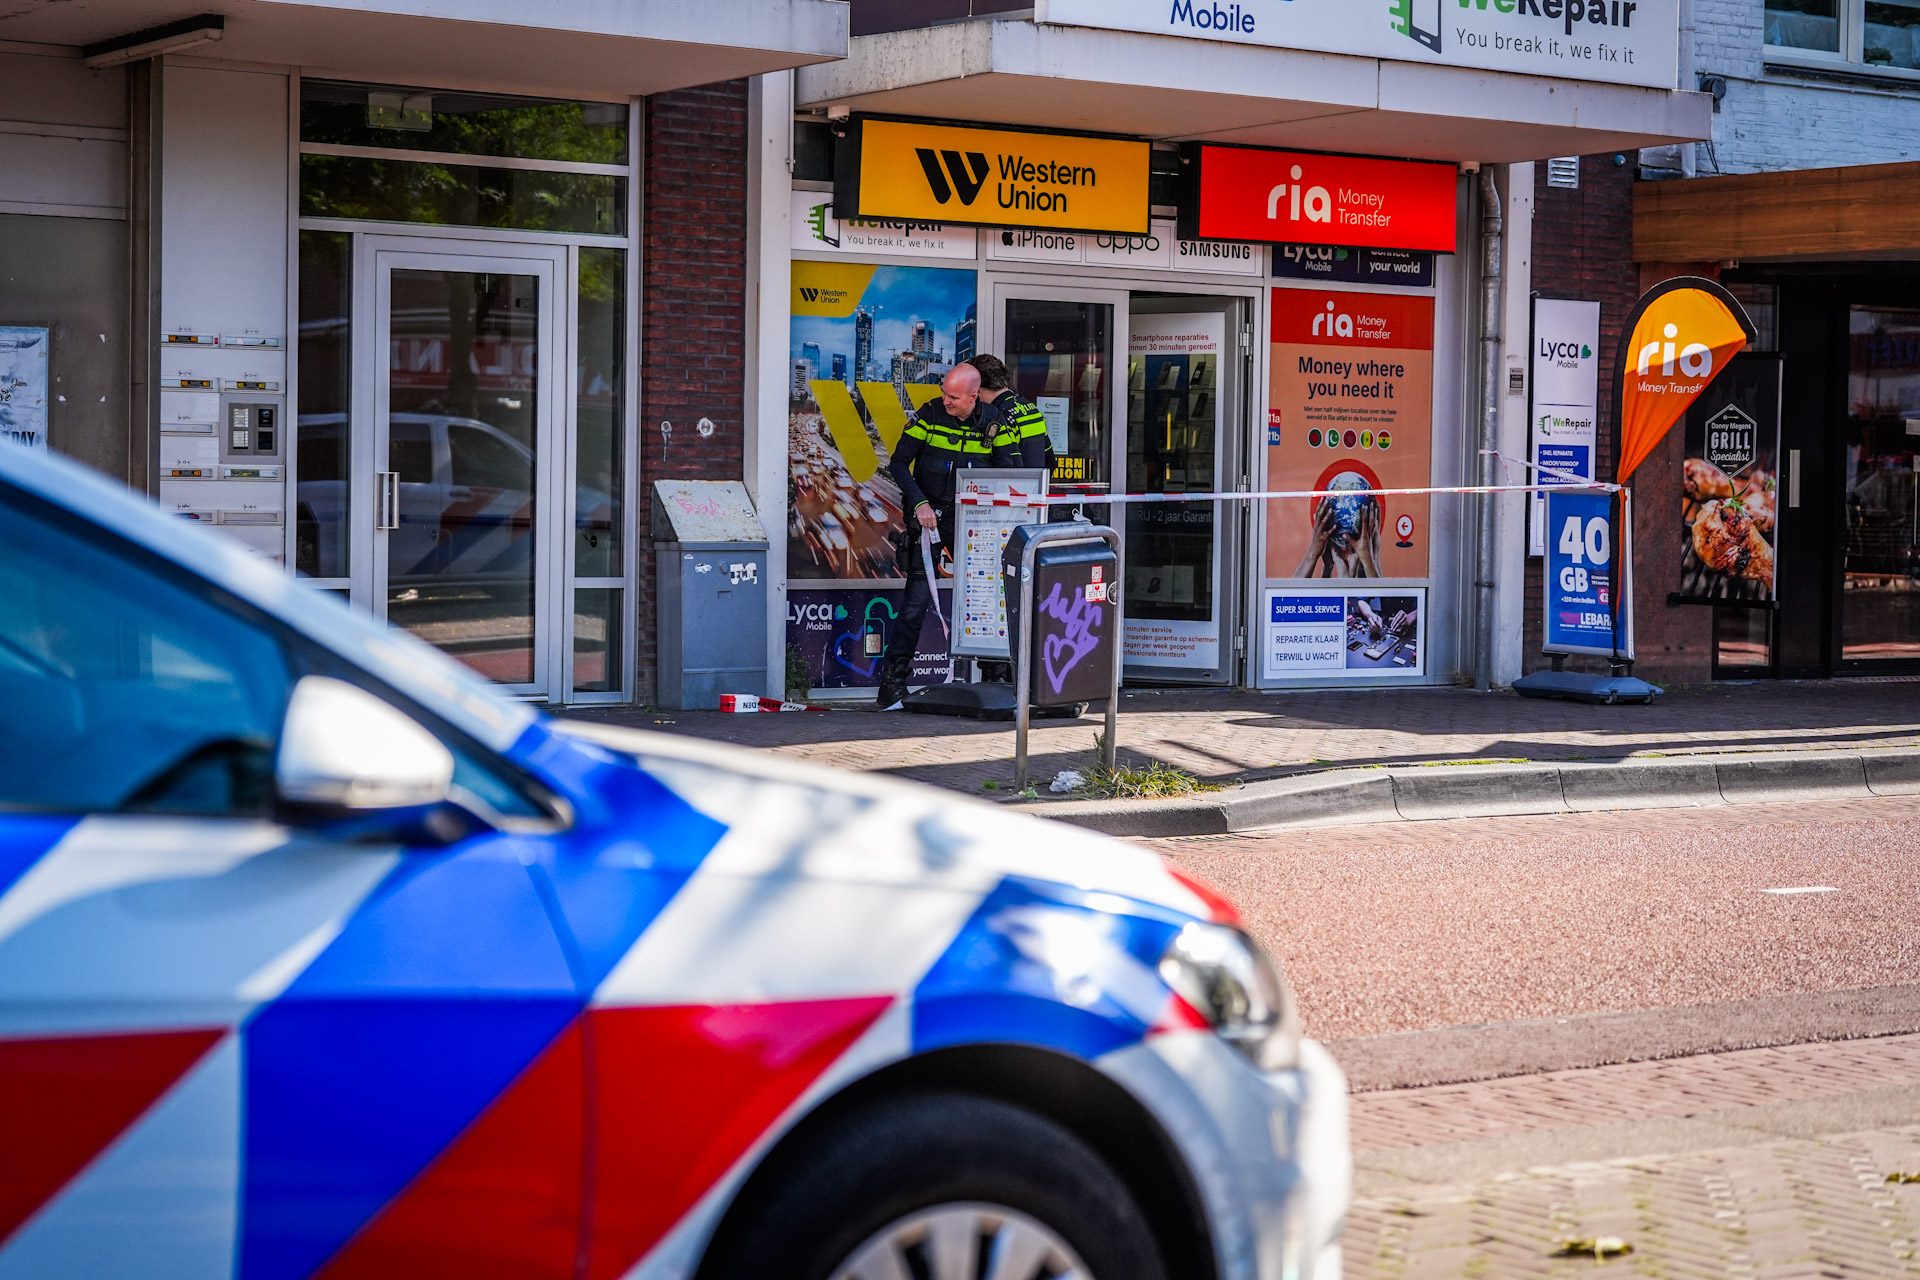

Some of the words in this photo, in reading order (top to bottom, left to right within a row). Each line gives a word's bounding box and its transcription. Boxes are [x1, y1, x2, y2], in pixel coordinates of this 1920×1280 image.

[1170, 0, 1255, 33] Mobile
[1456, 28, 1487, 48] You
[1495, 32, 1543, 53] break
[1549, 38, 1564, 58] it,
[1570, 46, 1592, 60] we
[1599, 44, 1618, 63] fix
[1624, 47, 1635, 63] it
[997, 154, 1096, 187] Western
[997, 182, 1068, 213] Union
[1267, 164, 1331, 224] ria
[1338, 188, 1384, 209] Money
[1338, 208, 1392, 228] Transfer
[847, 235, 865, 245] You
[867, 236, 896, 247] break
[908, 239, 922, 248] we
[924, 238, 938, 249] fix
[938, 240, 945, 250] it
[1018, 229, 1075, 251] iPhone
[1095, 236, 1160, 254] oppo
[1180, 241, 1250, 259] SAMSUNG
[1305, 261, 1332, 272] Mobile
[1370, 262, 1391, 273] your
[1394, 262, 1421, 274] world
[821, 288, 848, 298] Western
[821, 297, 841, 305] Union
[1312, 300, 1353, 338] ria
[1357, 315, 1387, 327] Money
[1131, 334, 1173, 343] Smartphone
[1174, 333, 1209, 343] reparaties
[1357, 328, 1391, 340] Transfer
[1129, 344, 1147, 352] innen
[1159, 343, 1187, 351] minuten
[1540, 338, 1579, 361] Lyca
[1637, 323, 1713, 378] ria
[1298, 356, 1352, 380] Money
[1356, 360, 1404, 377] where
[1556, 360, 1579, 369] Mobile
[1308, 382, 1337, 400] you
[1341, 381, 1380, 399] need
[1383, 381, 1394, 398] it
[1638, 381, 1667, 395] Money
[1553, 418, 1592, 430] WeRepair
[1711, 423, 1730, 432] Danny
[1711, 432, 1751, 450] GRILL
[1711, 449, 1750, 464] Specialist
[1052, 468, 1082, 479] NION
[1164, 511, 1180, 524] jaar
[1558, 516, 1611, 566] 40
[1559, 566, 1589, 593] GB
[786, 600, 833, 625] Lyca
[1275, 605, 1297, 614] SUPER
[1298, 605, 1313, 614] SNEL
[1314, 605, 1341, 614] SERVICE
[806, 621, 832, 630] Mobile
[1580, 612, 1611, 626] LEBAR
[1123, 641, 1141, 649] dagen
[1275, 635, 1313, 644] REPARATIE
[1314, 634, 1339, 644] KLAAR
[913, 651, 948, 661] Connect
[1275, 653, 1304, 661] TERWIJL
[1305, 652, 1311, 661] U
[1312, 652, 1339, 661] WACHT
[913, 666, 933, 678] your
[934, 665, 950, 675] wor
